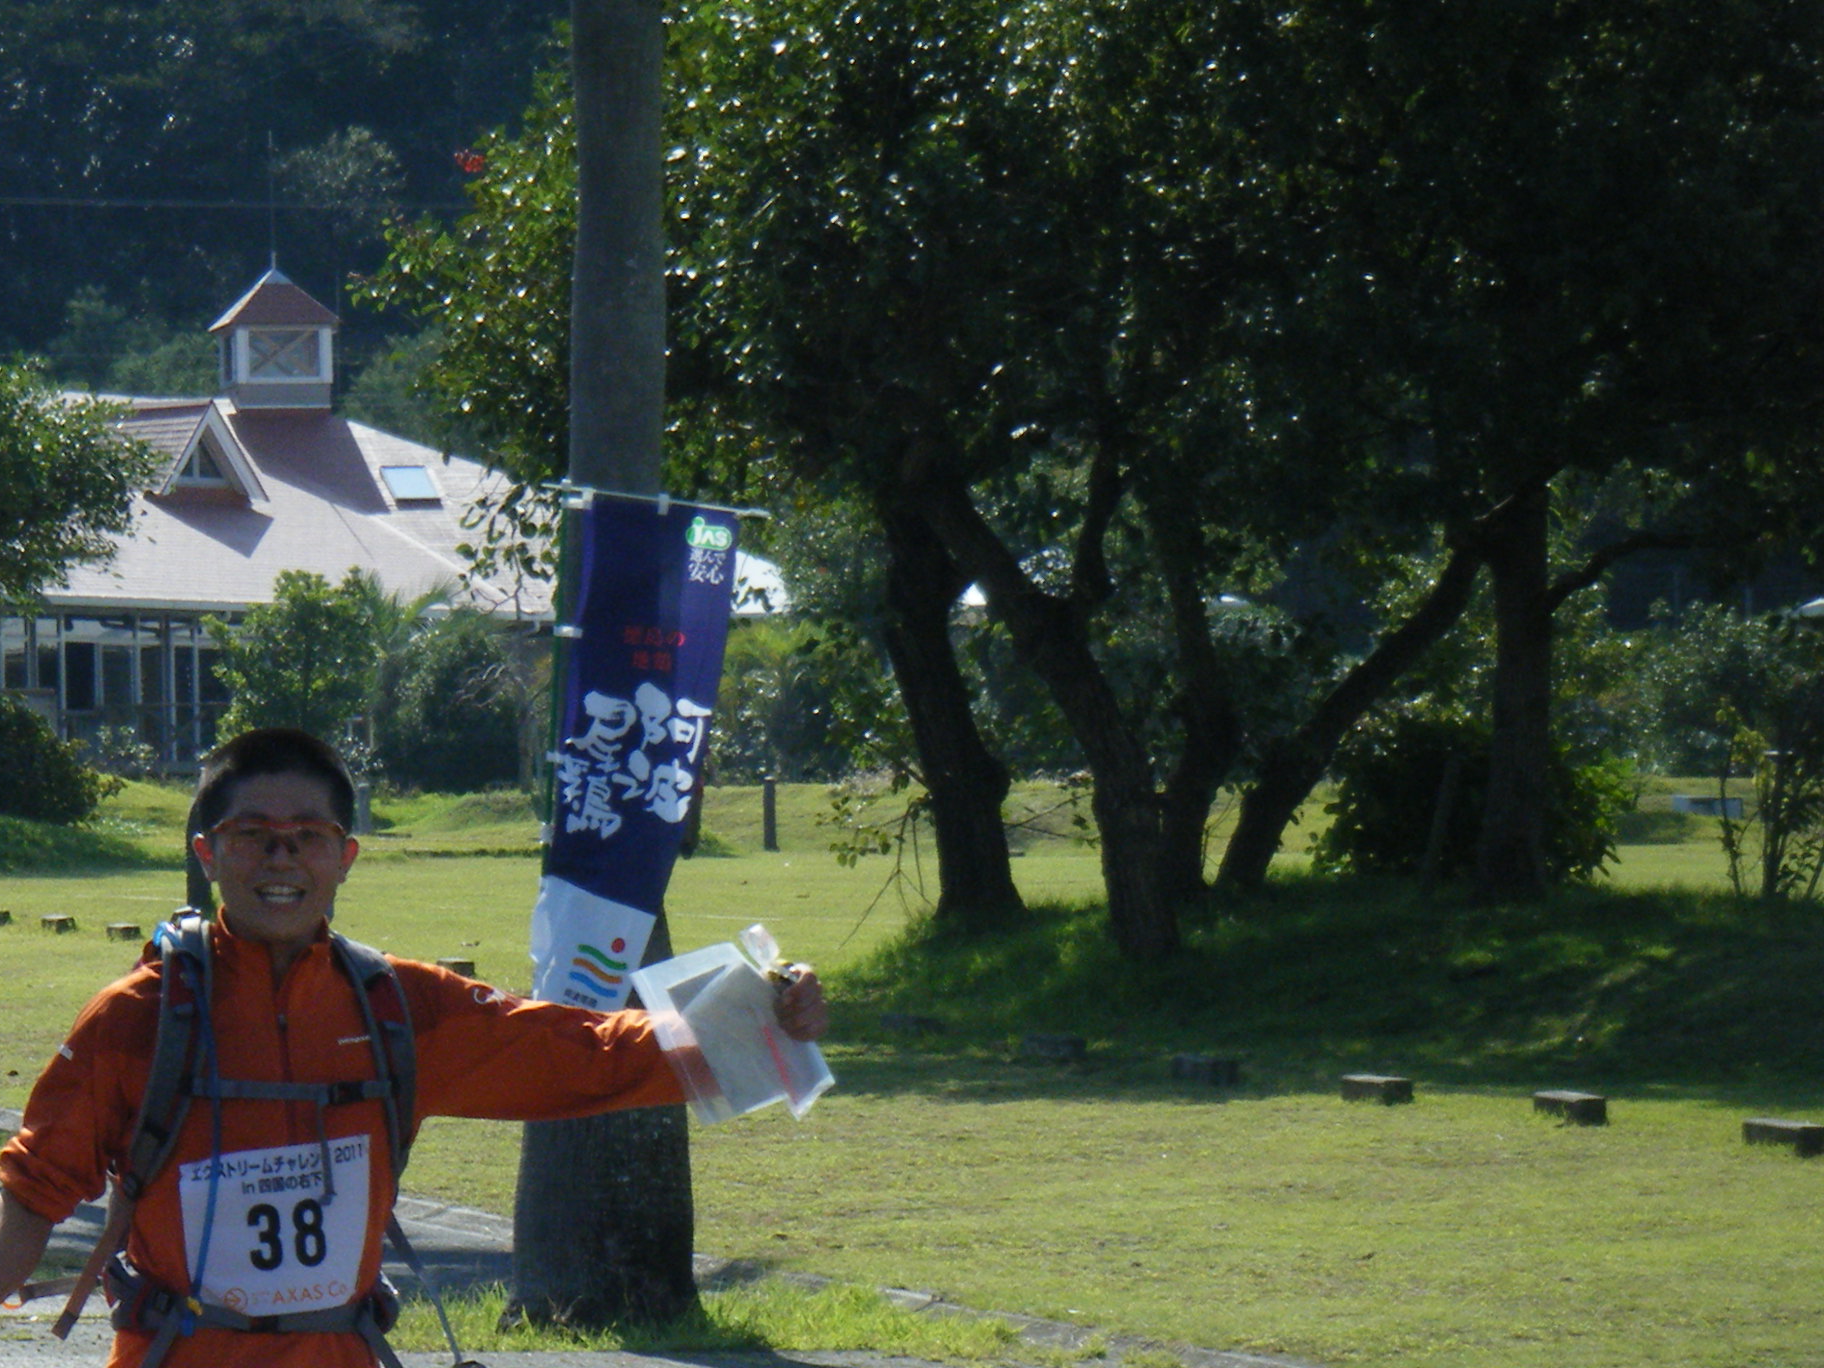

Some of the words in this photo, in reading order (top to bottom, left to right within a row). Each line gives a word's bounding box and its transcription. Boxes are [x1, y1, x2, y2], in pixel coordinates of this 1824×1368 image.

[334, 1143, 363, 1164] 2011
[247, 1198, 327, 1271] 38
[272, 1283, 325, 1304] AXAS
